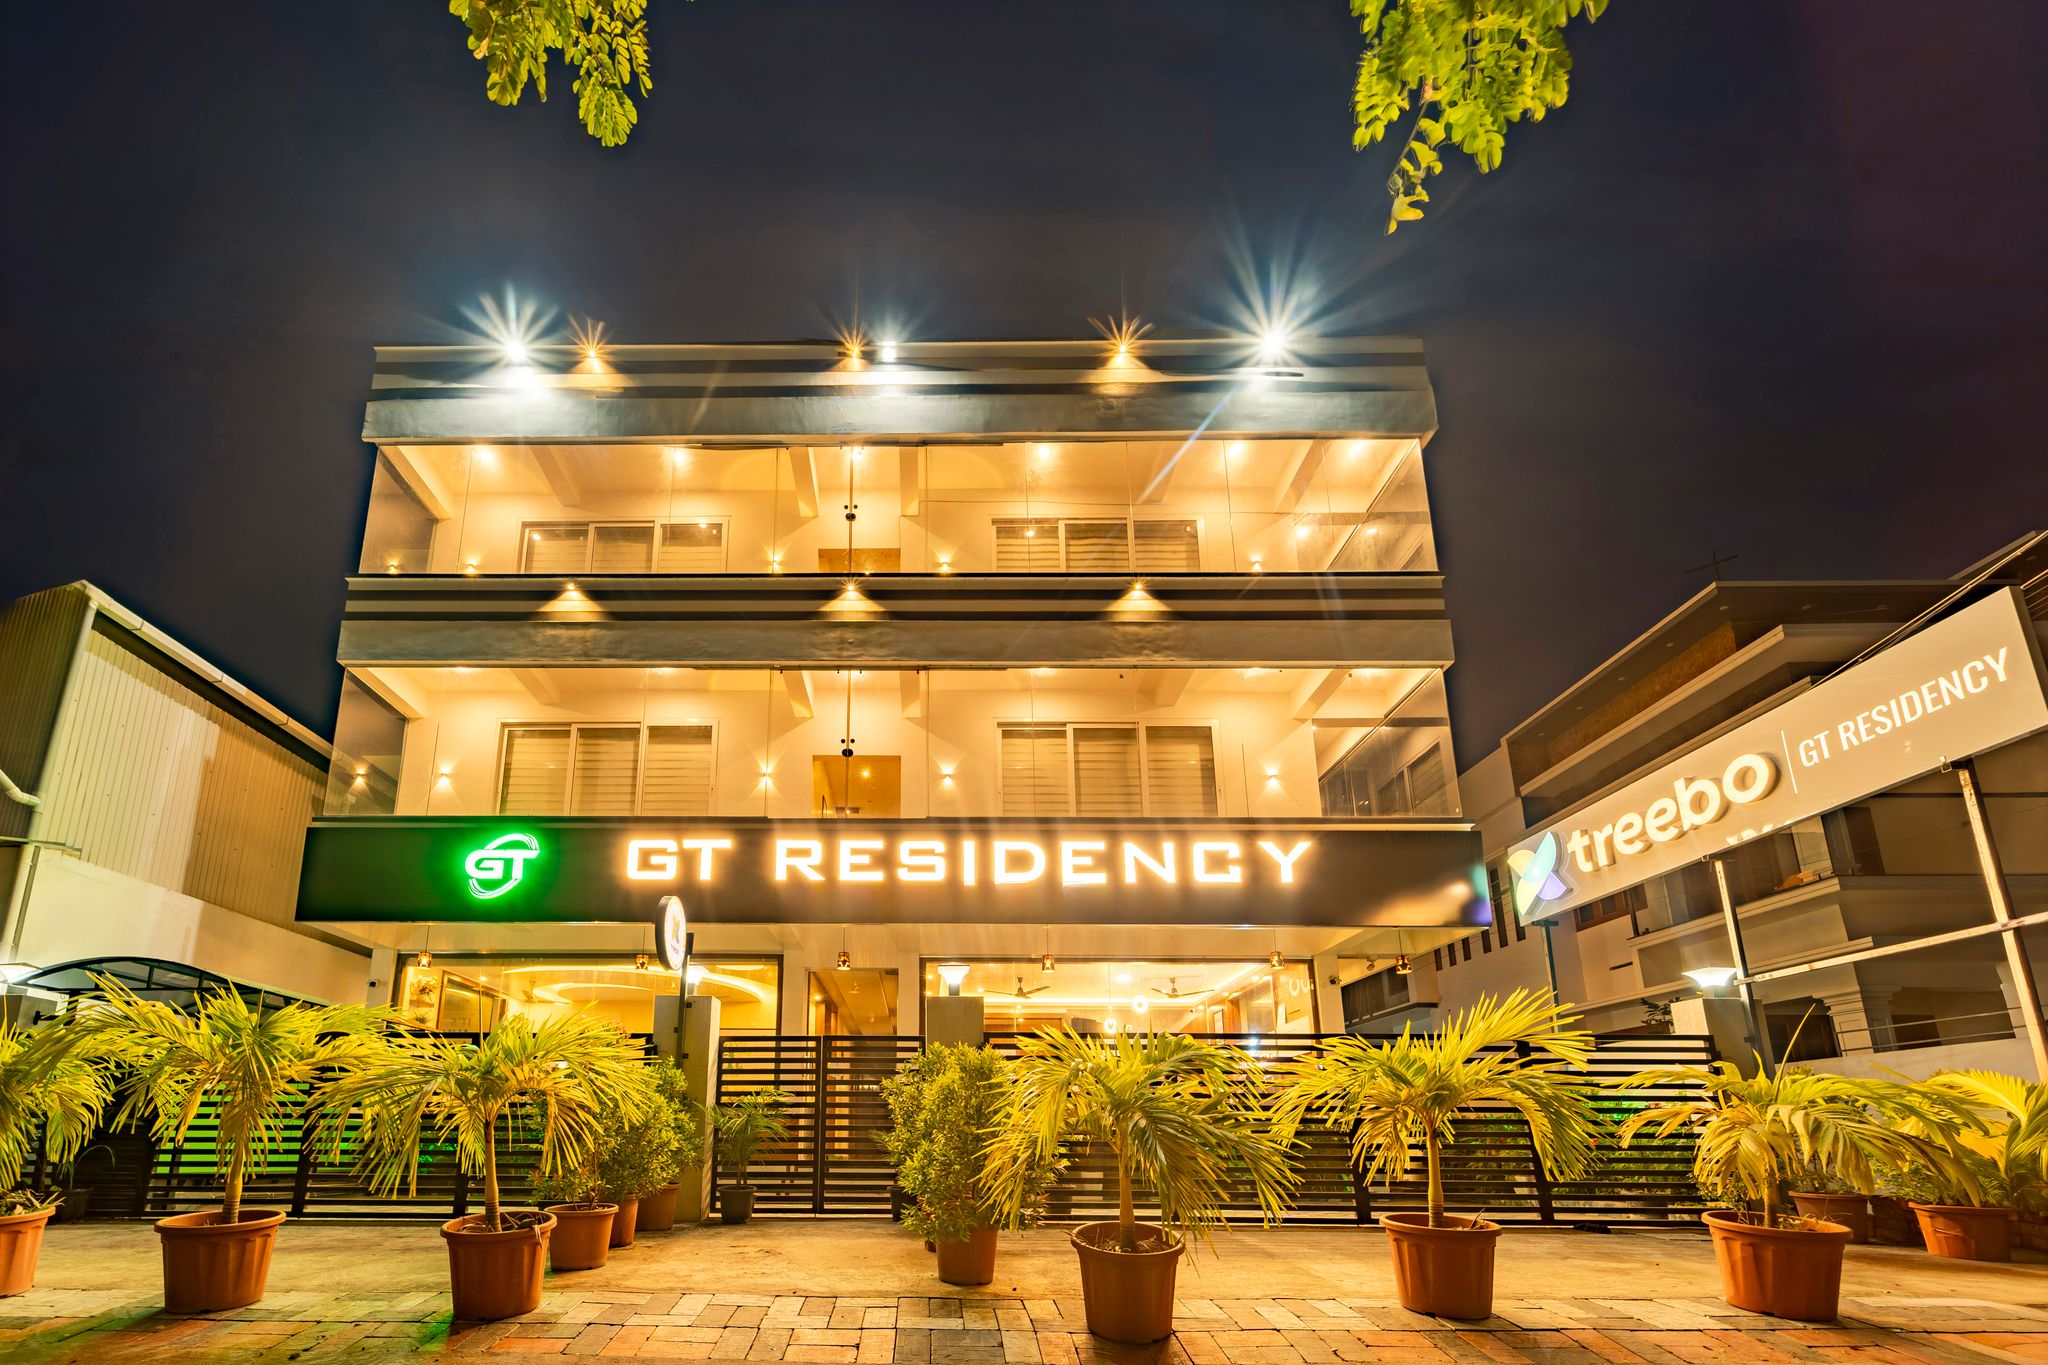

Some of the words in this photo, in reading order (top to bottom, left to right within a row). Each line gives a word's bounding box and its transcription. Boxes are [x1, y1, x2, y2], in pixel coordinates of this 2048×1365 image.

[1799, 730, 1831, 768] GT
[1837, 647, 2008, 751] RESIDENCY
[1566, 753, 1776, 873] treebo
[463, 846, 541, 883] GT
[625, 838, 732, 881] GT
[774, 838, 1313, 886] RESIDENCY
